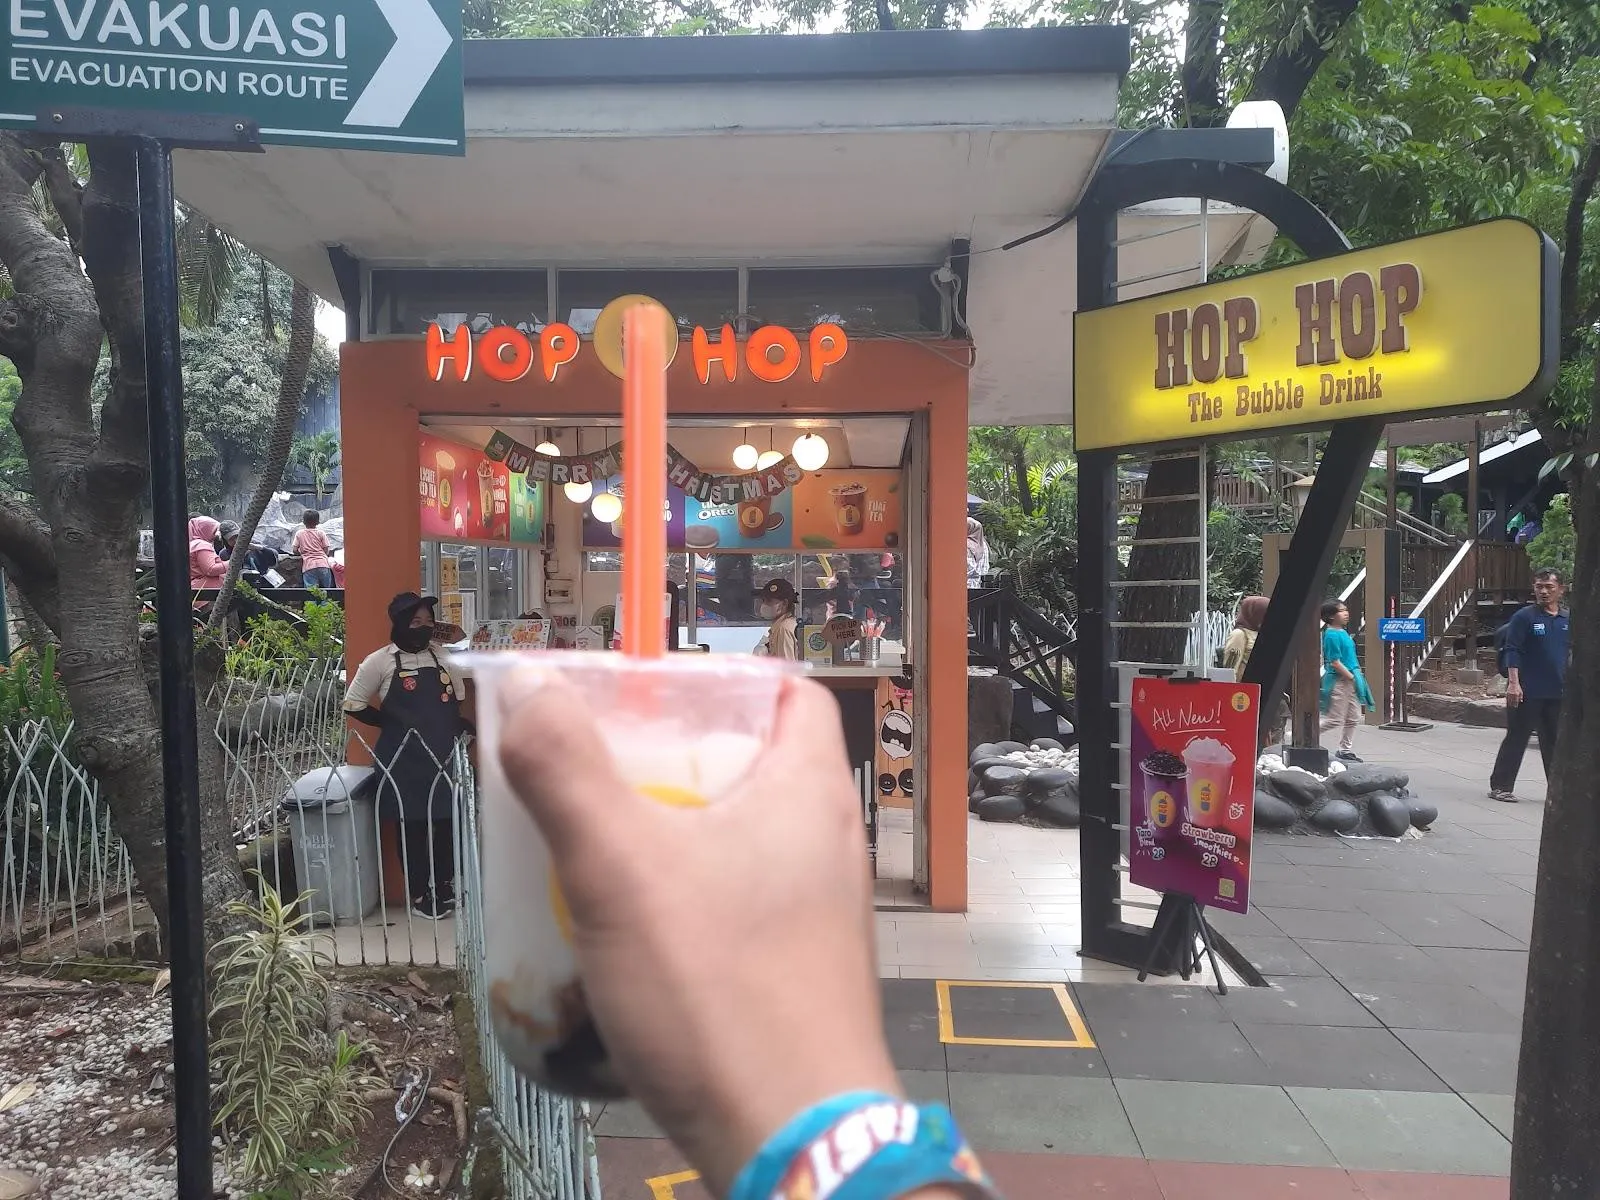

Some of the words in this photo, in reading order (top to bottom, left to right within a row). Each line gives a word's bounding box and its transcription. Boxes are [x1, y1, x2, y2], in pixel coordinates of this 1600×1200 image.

[10, 0, 346, 59] EVAKUASI
[9, 57, 227, 94] EVACUATION
[238, 72, 349, 100] ROUTE
[1153, 297, 1260, 390] HOP
[1294, 262, 1424, 367] HOP
[426, 322, 580, 382] HOP
[692, 322, 849, 385] HOP
[1187, 391, 1223, 423] The
[1235, 378, 1304, 414] Bubble
[1319, 366, 1383, 405] Drink
[507, 452, 610, 482] MERRY
[668, 456, 800, 503] HRISTMAS
[698, 508, 735, 520] OREO
[836, 629, 856, 640] HERE
[1153, 707, 1175, 731] All
[1179, 700, 1221, 728] New!
[1181, 822, 1236, 848] Strawberry
